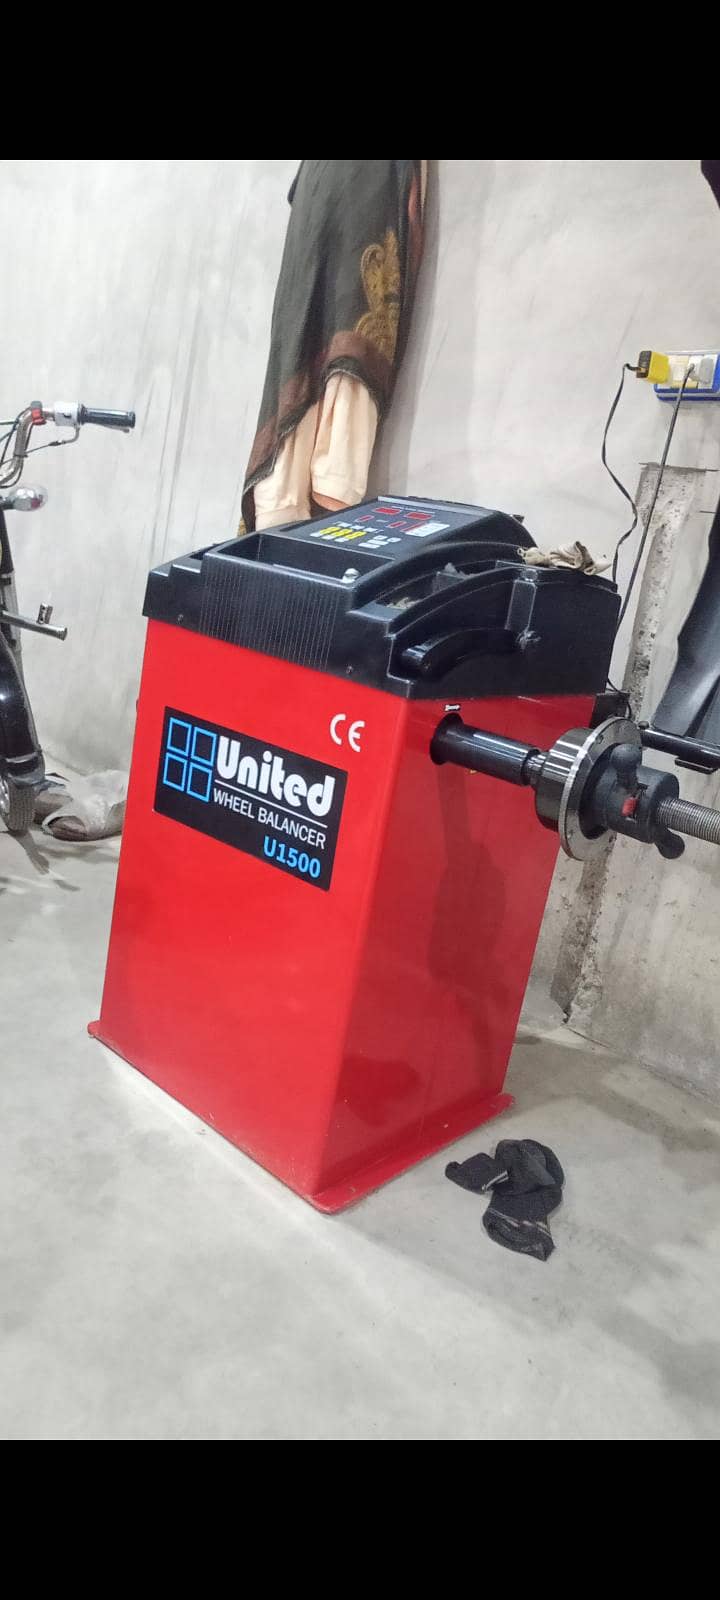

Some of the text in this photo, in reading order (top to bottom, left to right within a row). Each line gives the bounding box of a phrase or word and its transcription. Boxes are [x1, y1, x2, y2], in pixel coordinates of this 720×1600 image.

[329, 713, 366, 753] CE
[216, 735, 336, 817] United
[213, 788, 327, 850] WHEEL BALANCER
[263, 836, 321, 878] U1500
